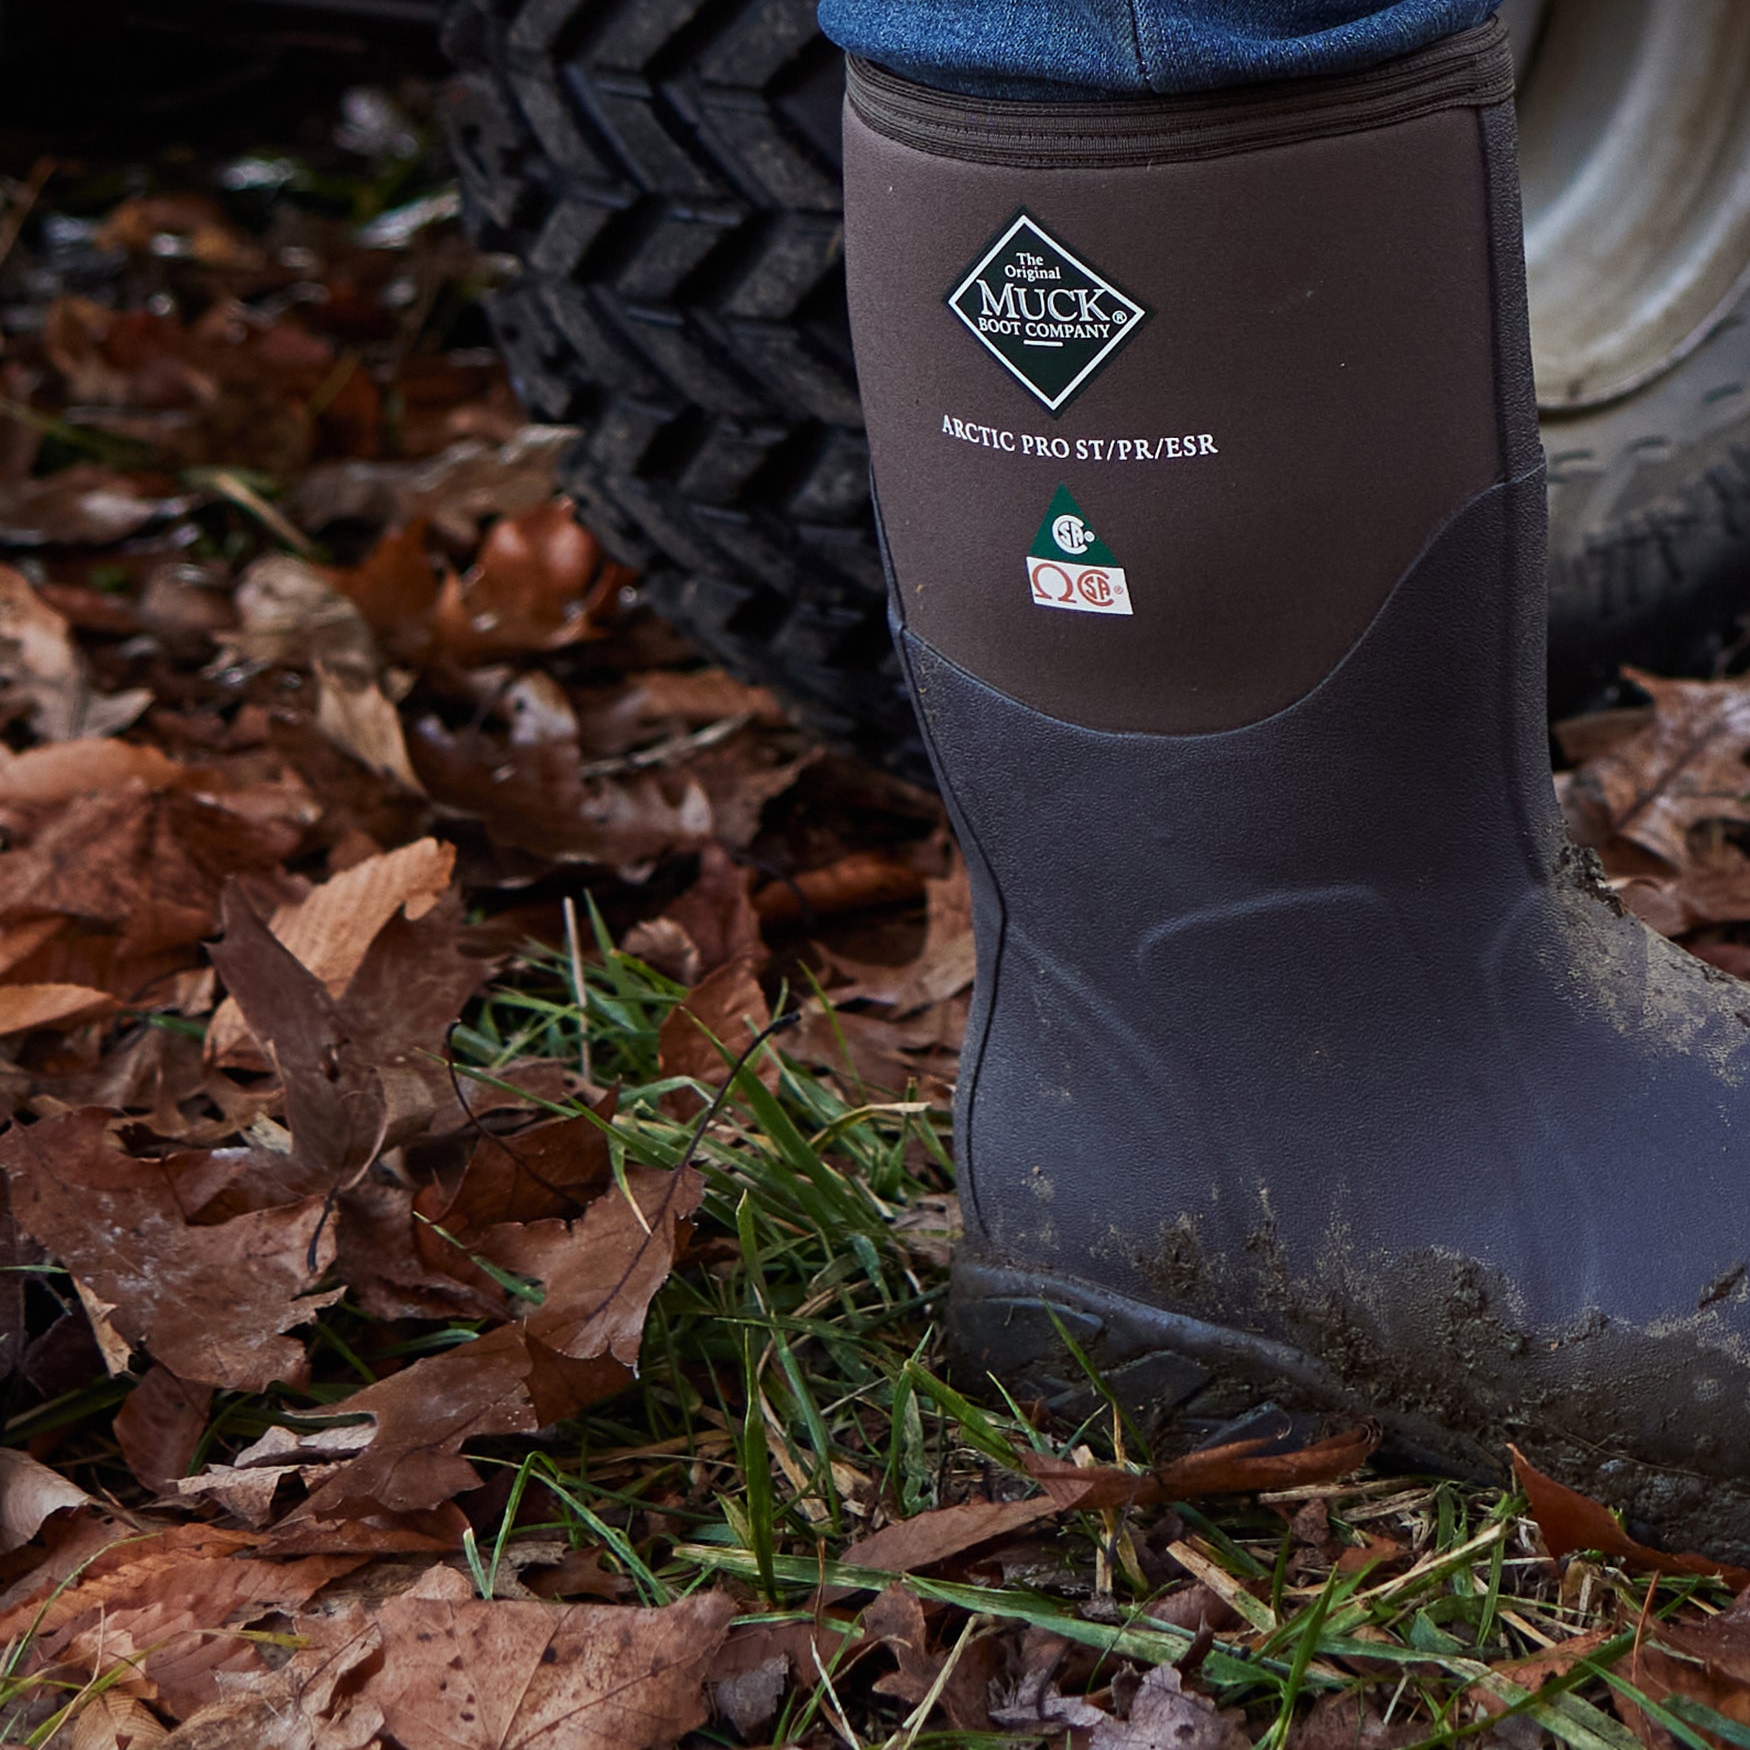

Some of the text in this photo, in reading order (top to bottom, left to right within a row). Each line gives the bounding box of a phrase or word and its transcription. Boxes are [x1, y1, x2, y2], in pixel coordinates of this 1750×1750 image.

[1016, 252, 1044, 266] The
[1004, 265, 1061, 282] Original
[978, 317, 1110, 339] BOOT COMPANY
[942, 414, 1219, 461] ARCTIC PRO ST/PR/ESR
